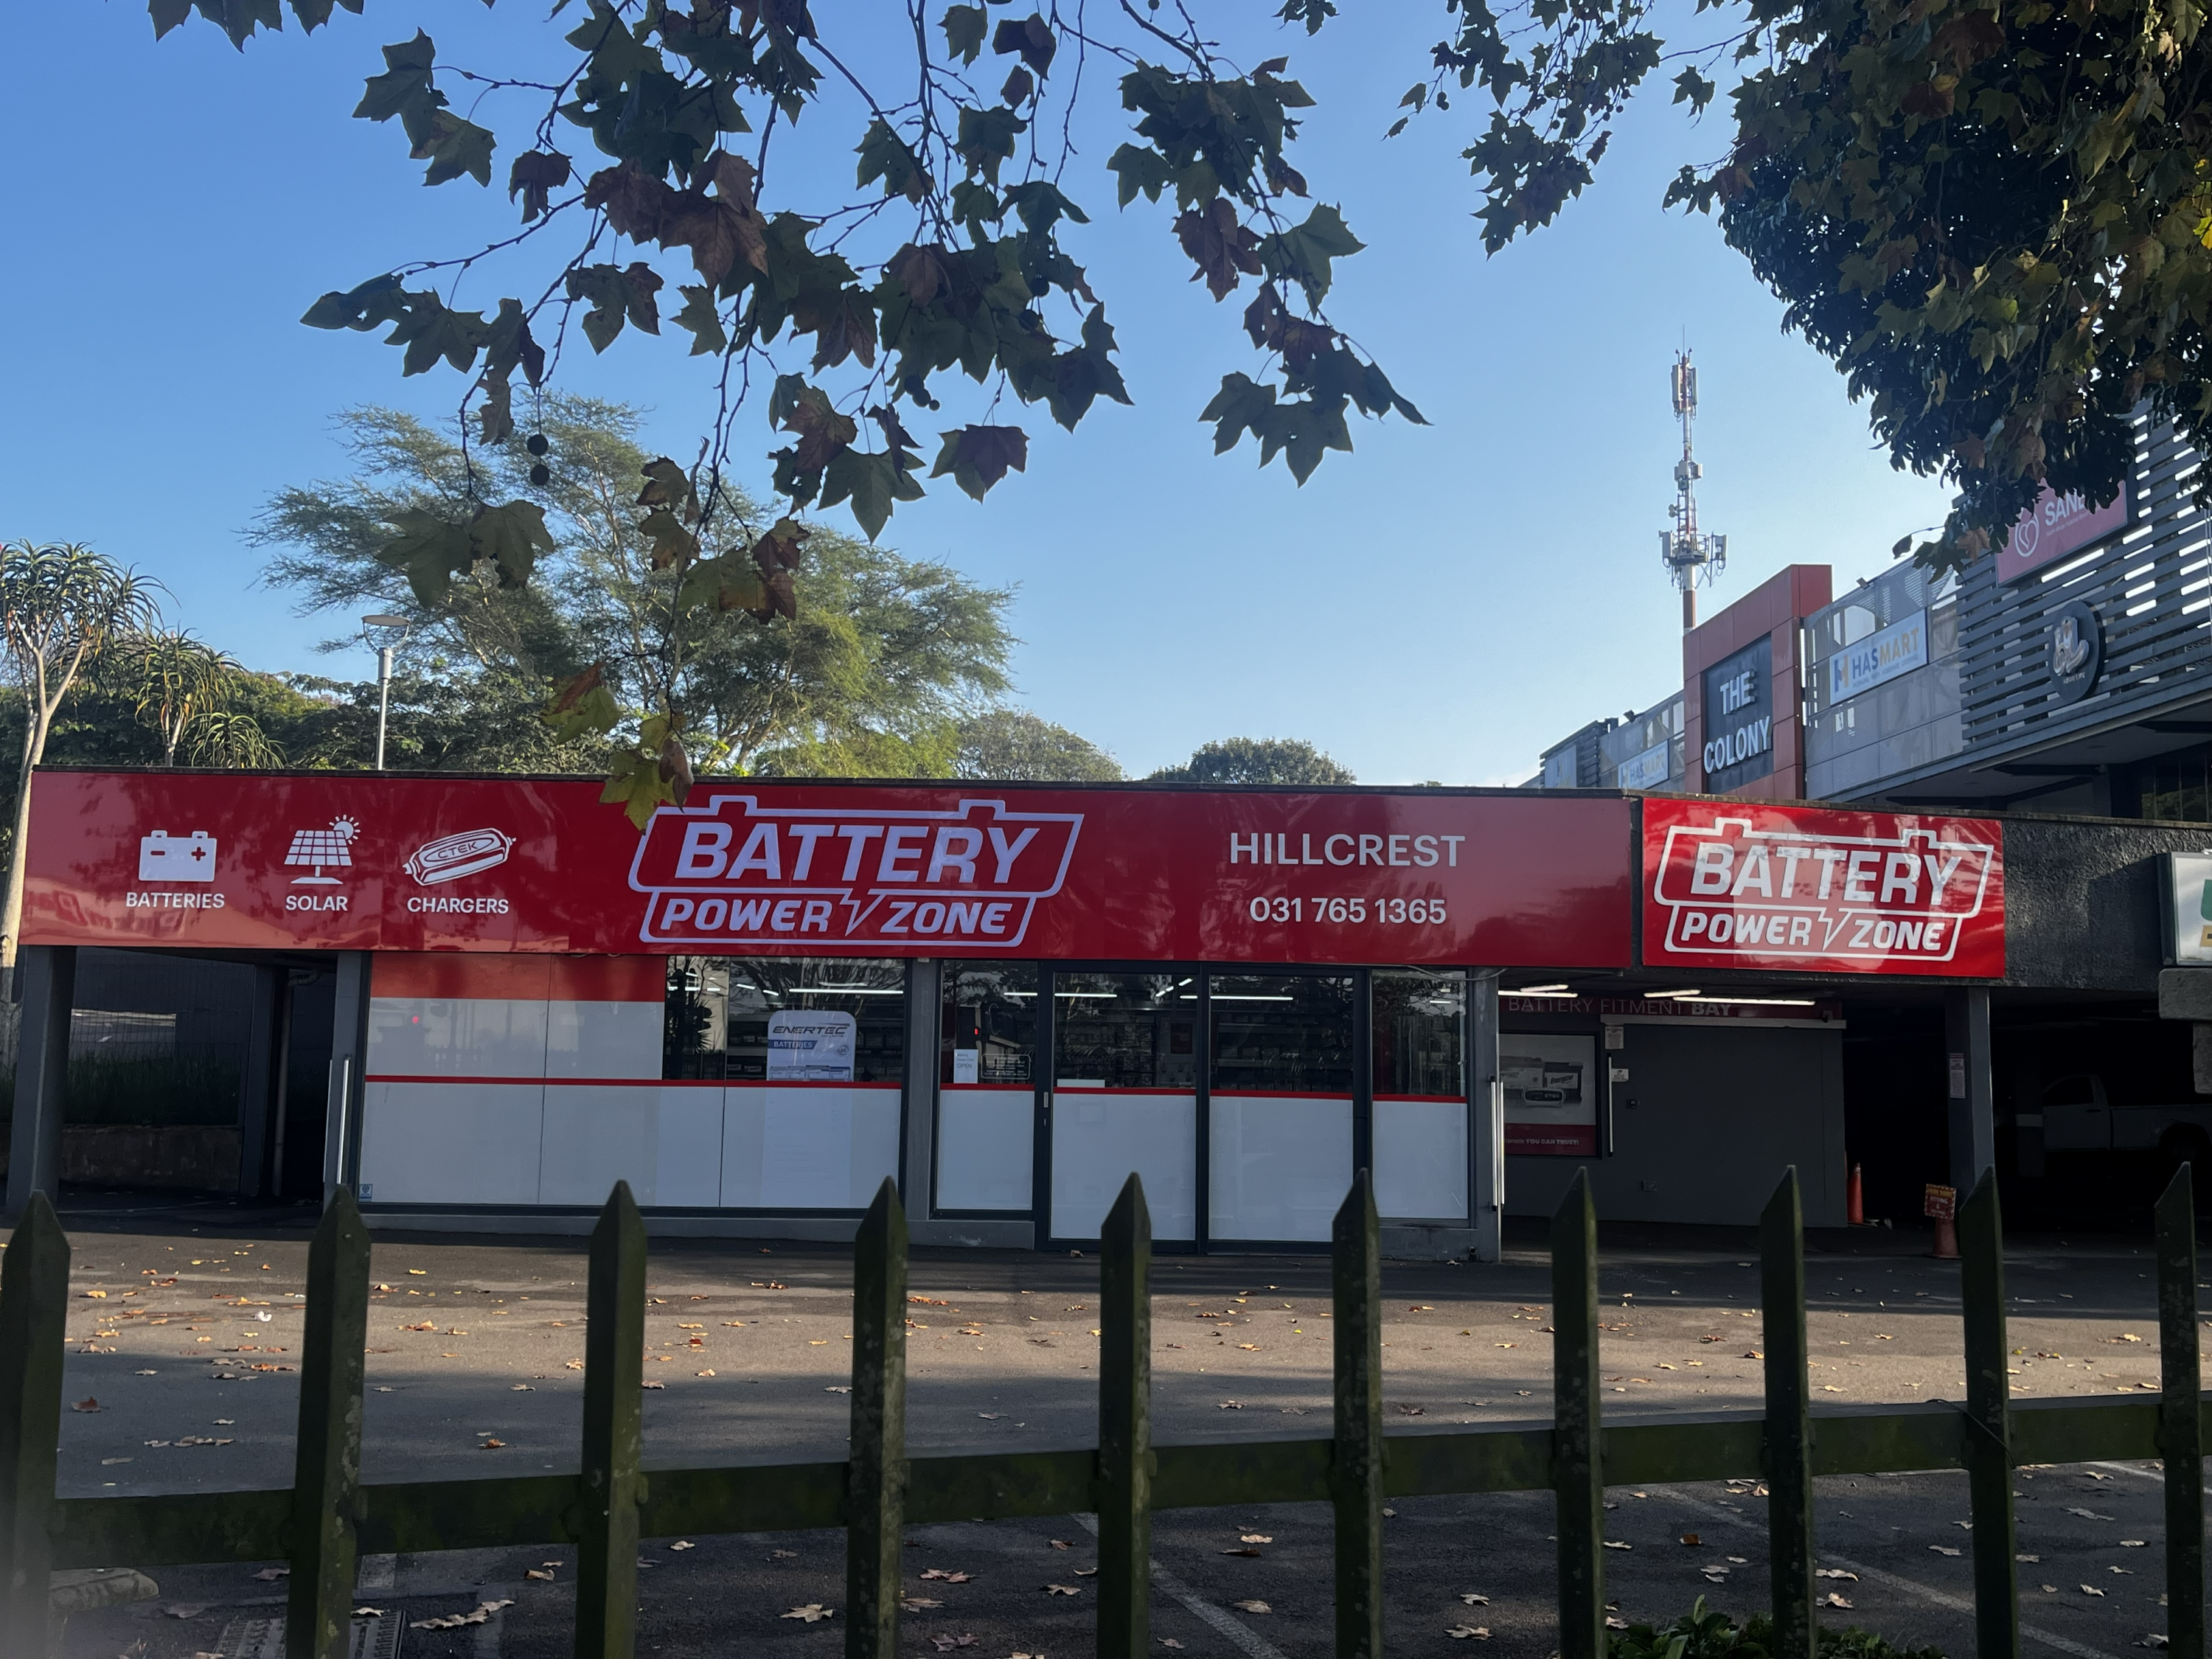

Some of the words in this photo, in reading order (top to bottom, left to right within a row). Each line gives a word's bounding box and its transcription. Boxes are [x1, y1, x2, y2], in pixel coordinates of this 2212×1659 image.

[1852, 626, 1919, 679] HASMART
[1719, 670, 1755, 715] THE
[1703, 715, 1770, 773] COLONY
[438, 841, 479, 859] CTEK
[674, 821, 1040, 884] BATTERY
[1230, 832, 1466, 867] HILLCREST
[1690, 841, 1963, 905] BATTERY
[125, 891, 225, 909] BATTERIES
[285, 895, 348, 911] SOLAR
[406, 897, 509, 914] CHARGERS
[660, 898, 832, 932] POWER
[880, 901, 1012, 934] ZONE
[1249, 897, 1302, 922] 031
[1311, 897, 1366, 922] 765
[1374, 898, 1447, 924] 1365
[1680, 911, 1812, 945] POWER
[1847, 919, 1945, 950] ZONE
[1509, 998, 1594, 1013] BATTERY
[1601, 998, 1684, 1015] FITMENT
[1691, 1003, 1733, 1016] BAY
[773, 1026, 848, 1034] ENERTEC
